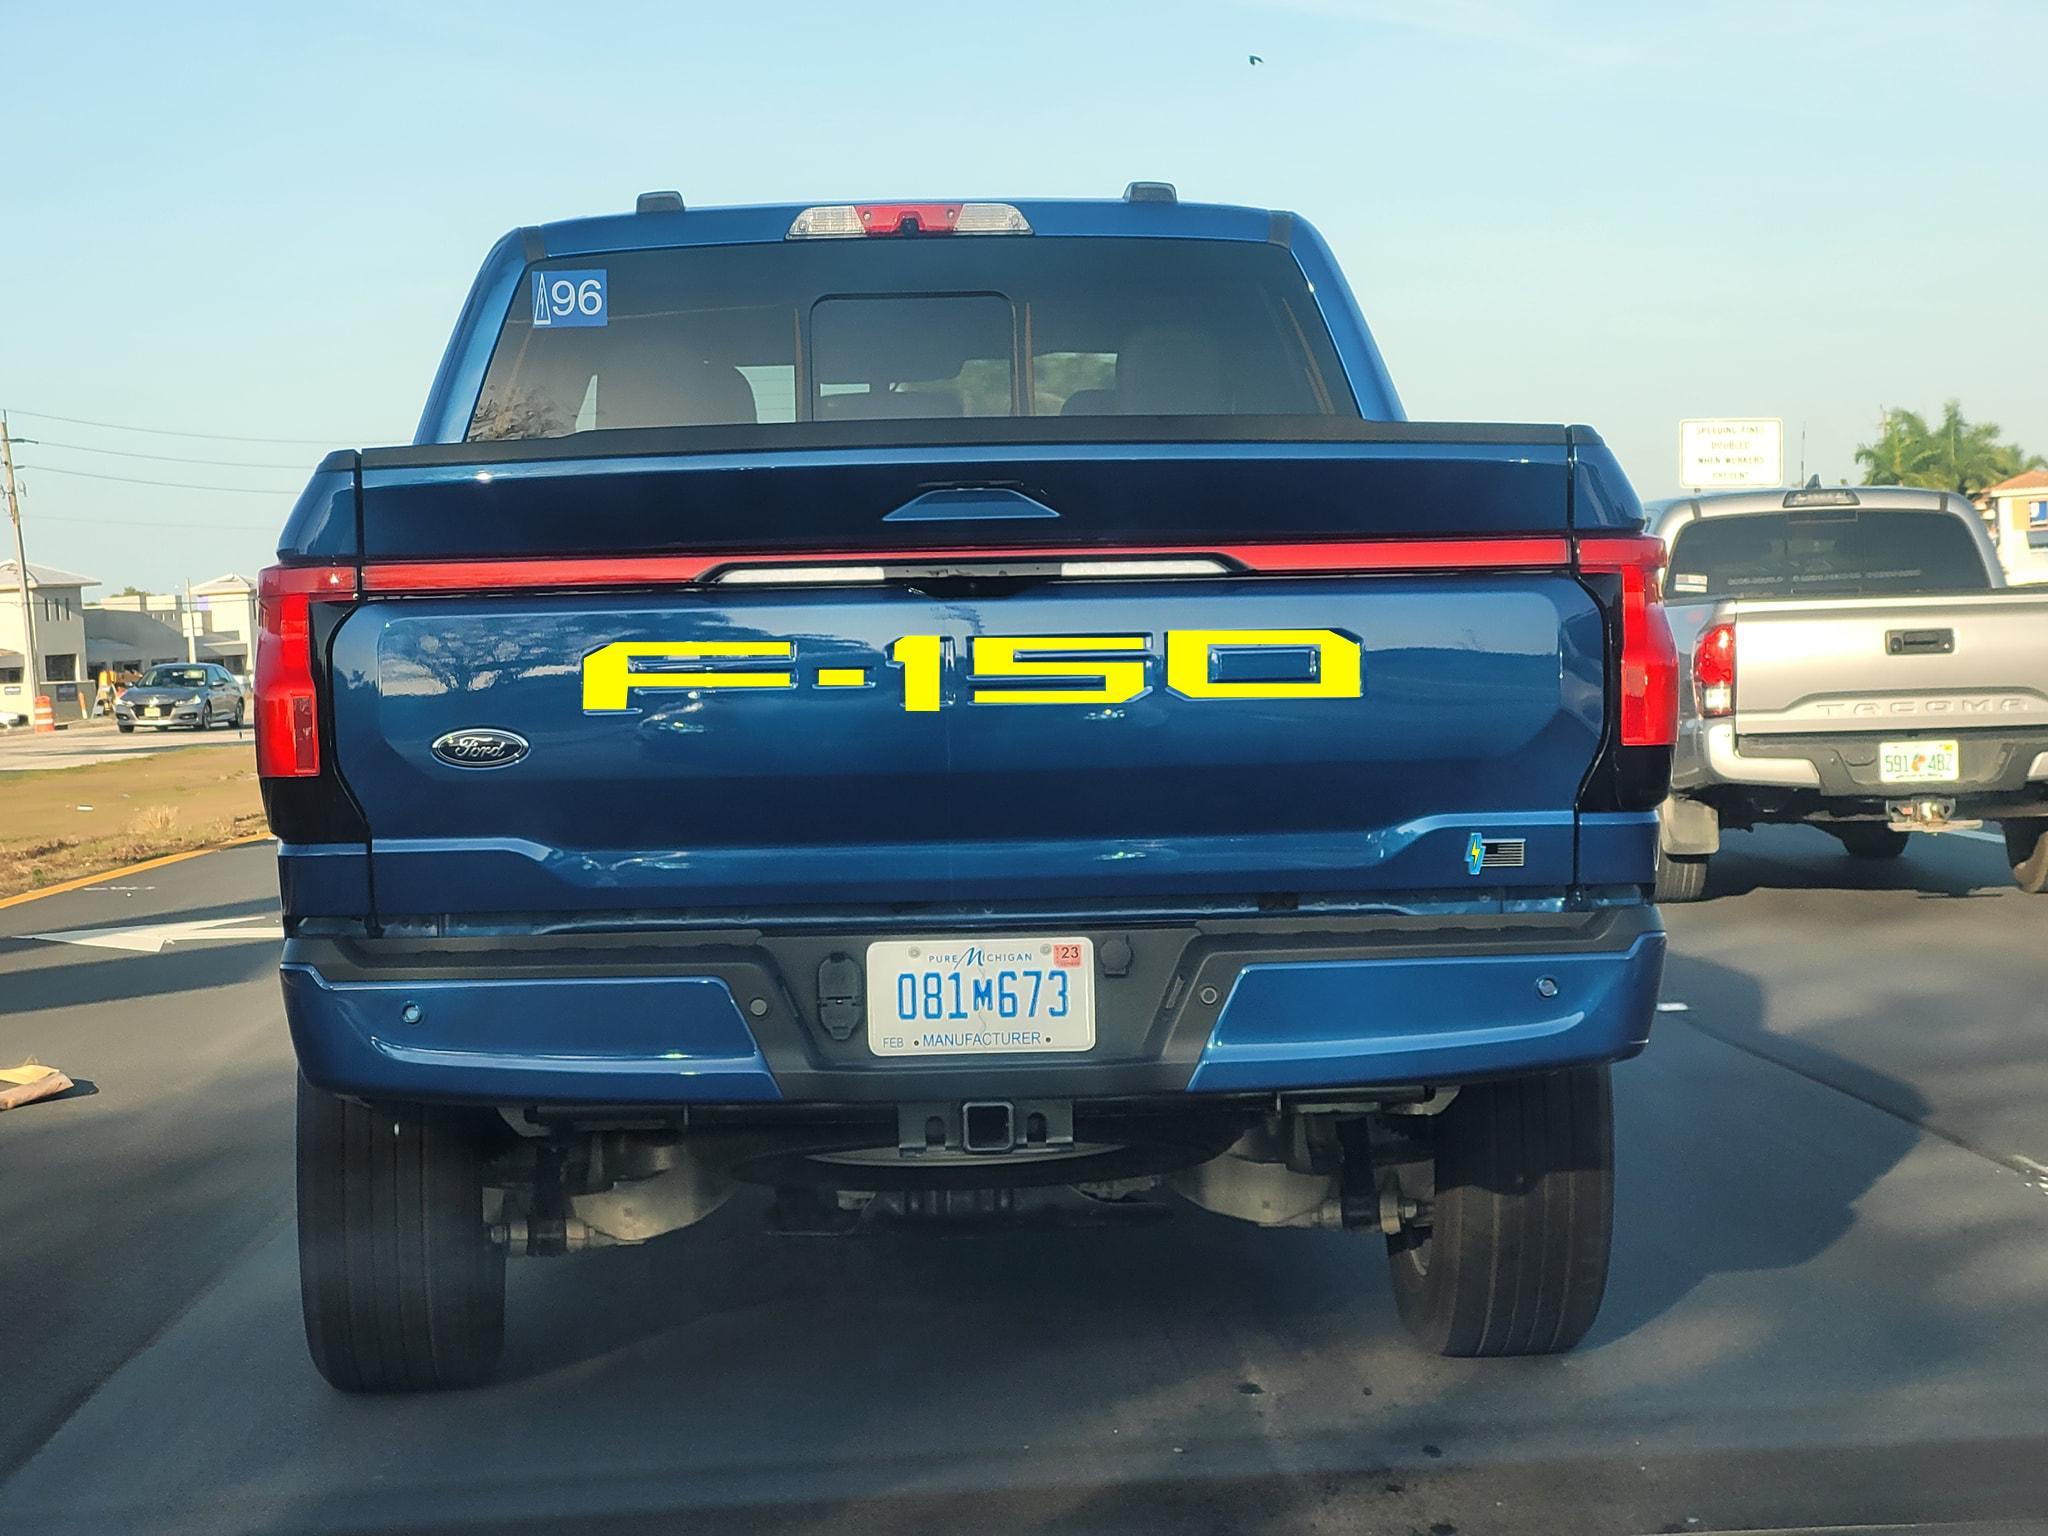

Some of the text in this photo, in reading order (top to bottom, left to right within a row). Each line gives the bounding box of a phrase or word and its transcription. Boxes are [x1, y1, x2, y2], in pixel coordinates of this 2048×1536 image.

[552, 279, 603, 316] 96
[580, 628, 1365, 715] F-150
[1815, 697, 2030, 716] TACOMA
[455, 736, 505, 757] Ford
[928, 954, 959, 963] PURE
[1061, 946, 1079, 959] 23
[882, 1037, 904, 1048] FEB
[922, 1031, 1041, 1048] MANUFACTURER
